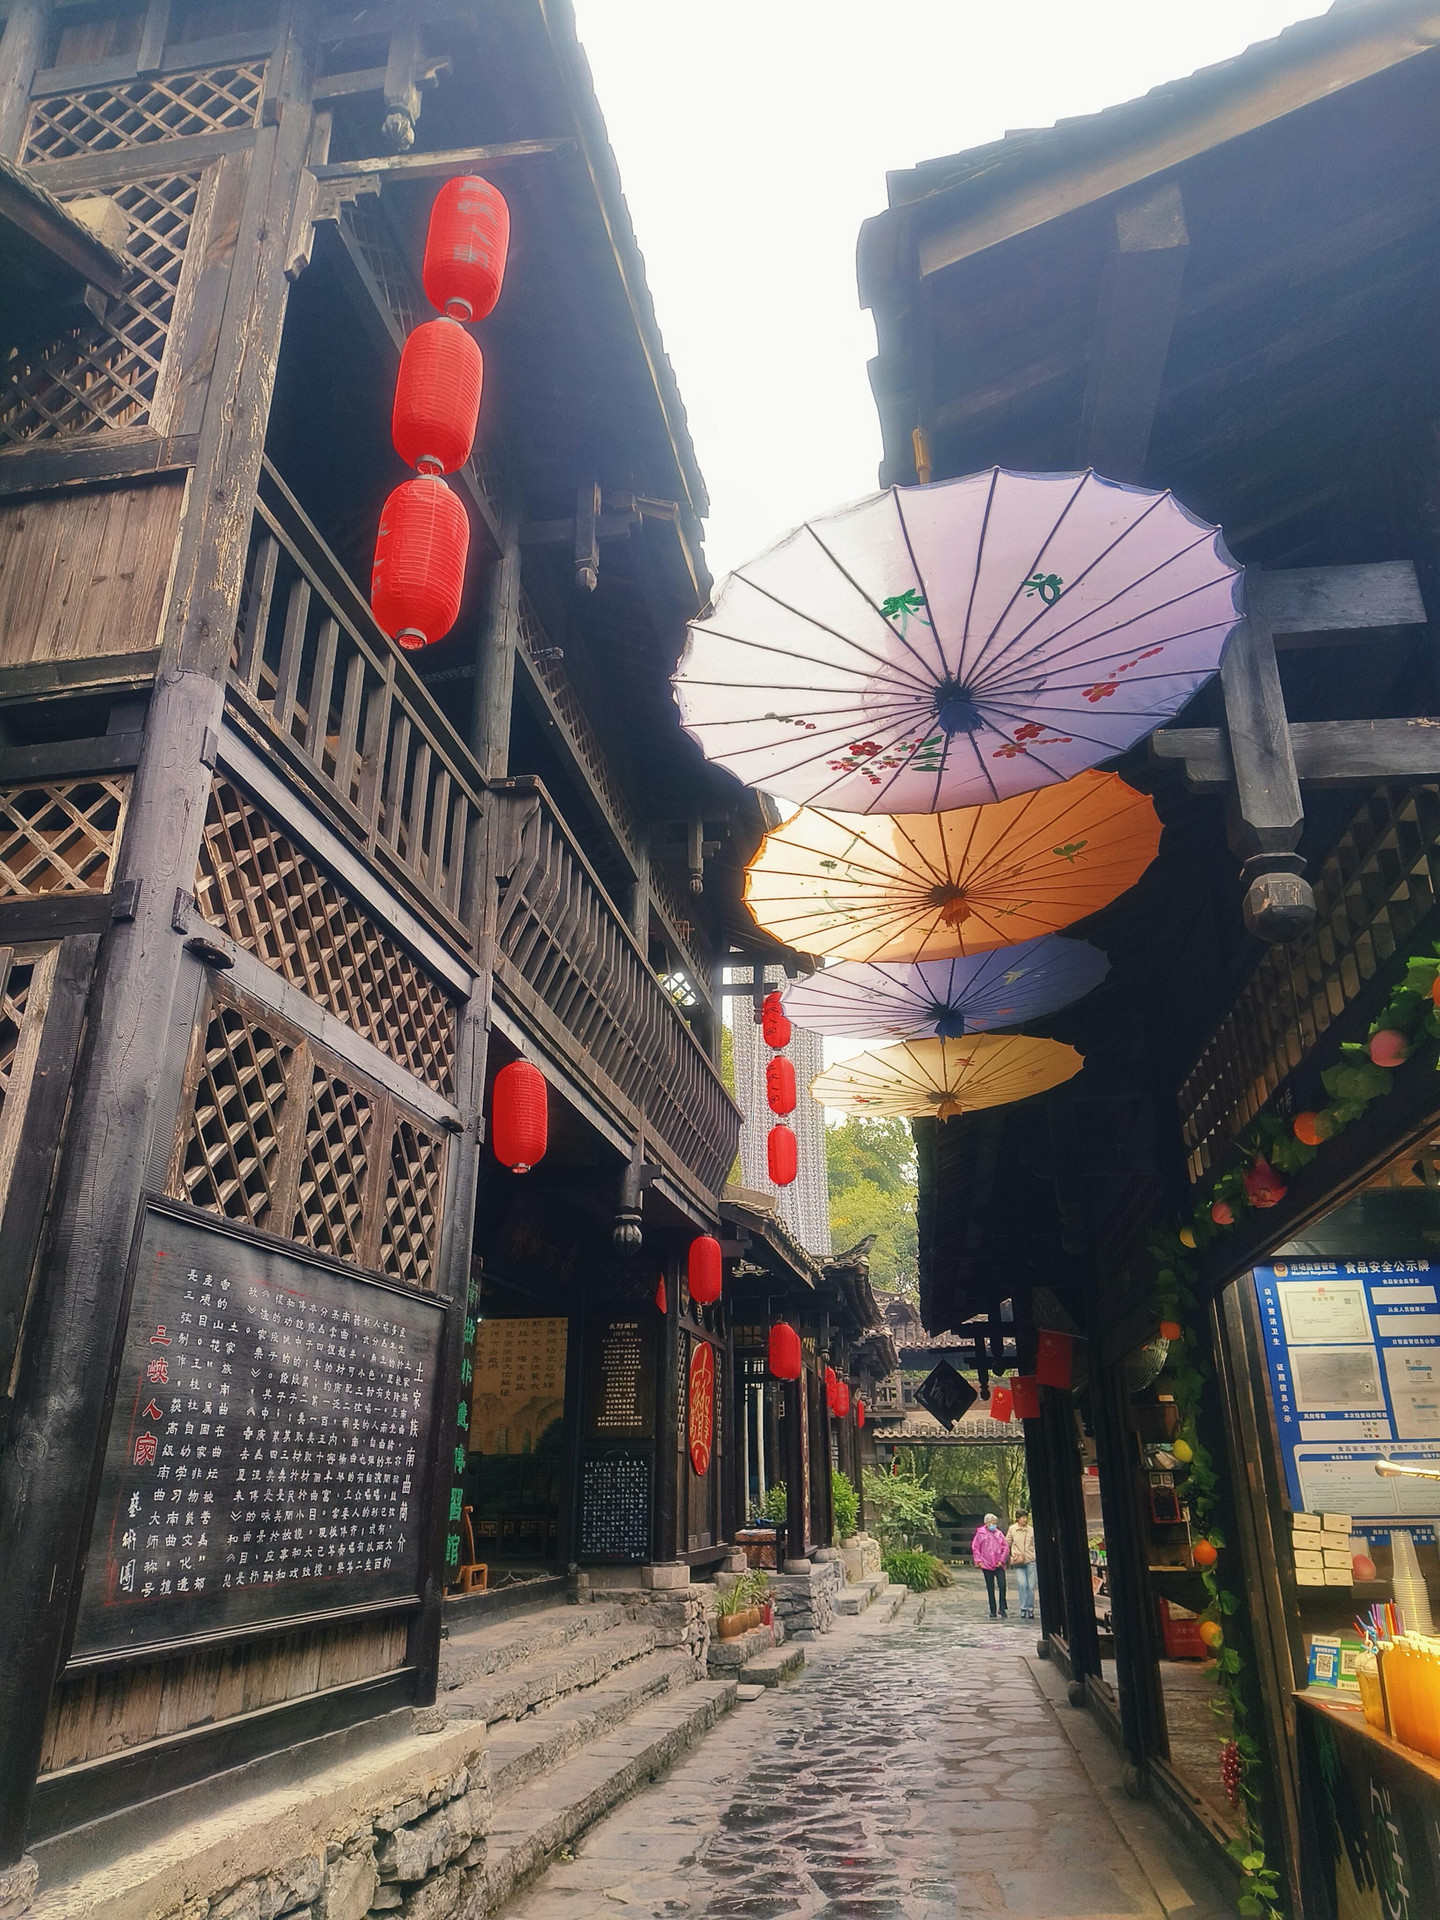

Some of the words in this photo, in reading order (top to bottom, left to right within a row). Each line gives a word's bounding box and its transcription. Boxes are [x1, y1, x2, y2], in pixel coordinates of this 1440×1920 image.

[1344, 1260, 1430, 1274] 食品安全公示牌
[1264, 1288, 1281, 1346] 店内整洁卫生
[1276, 1363, 1292, 1423] 证照信息公示
